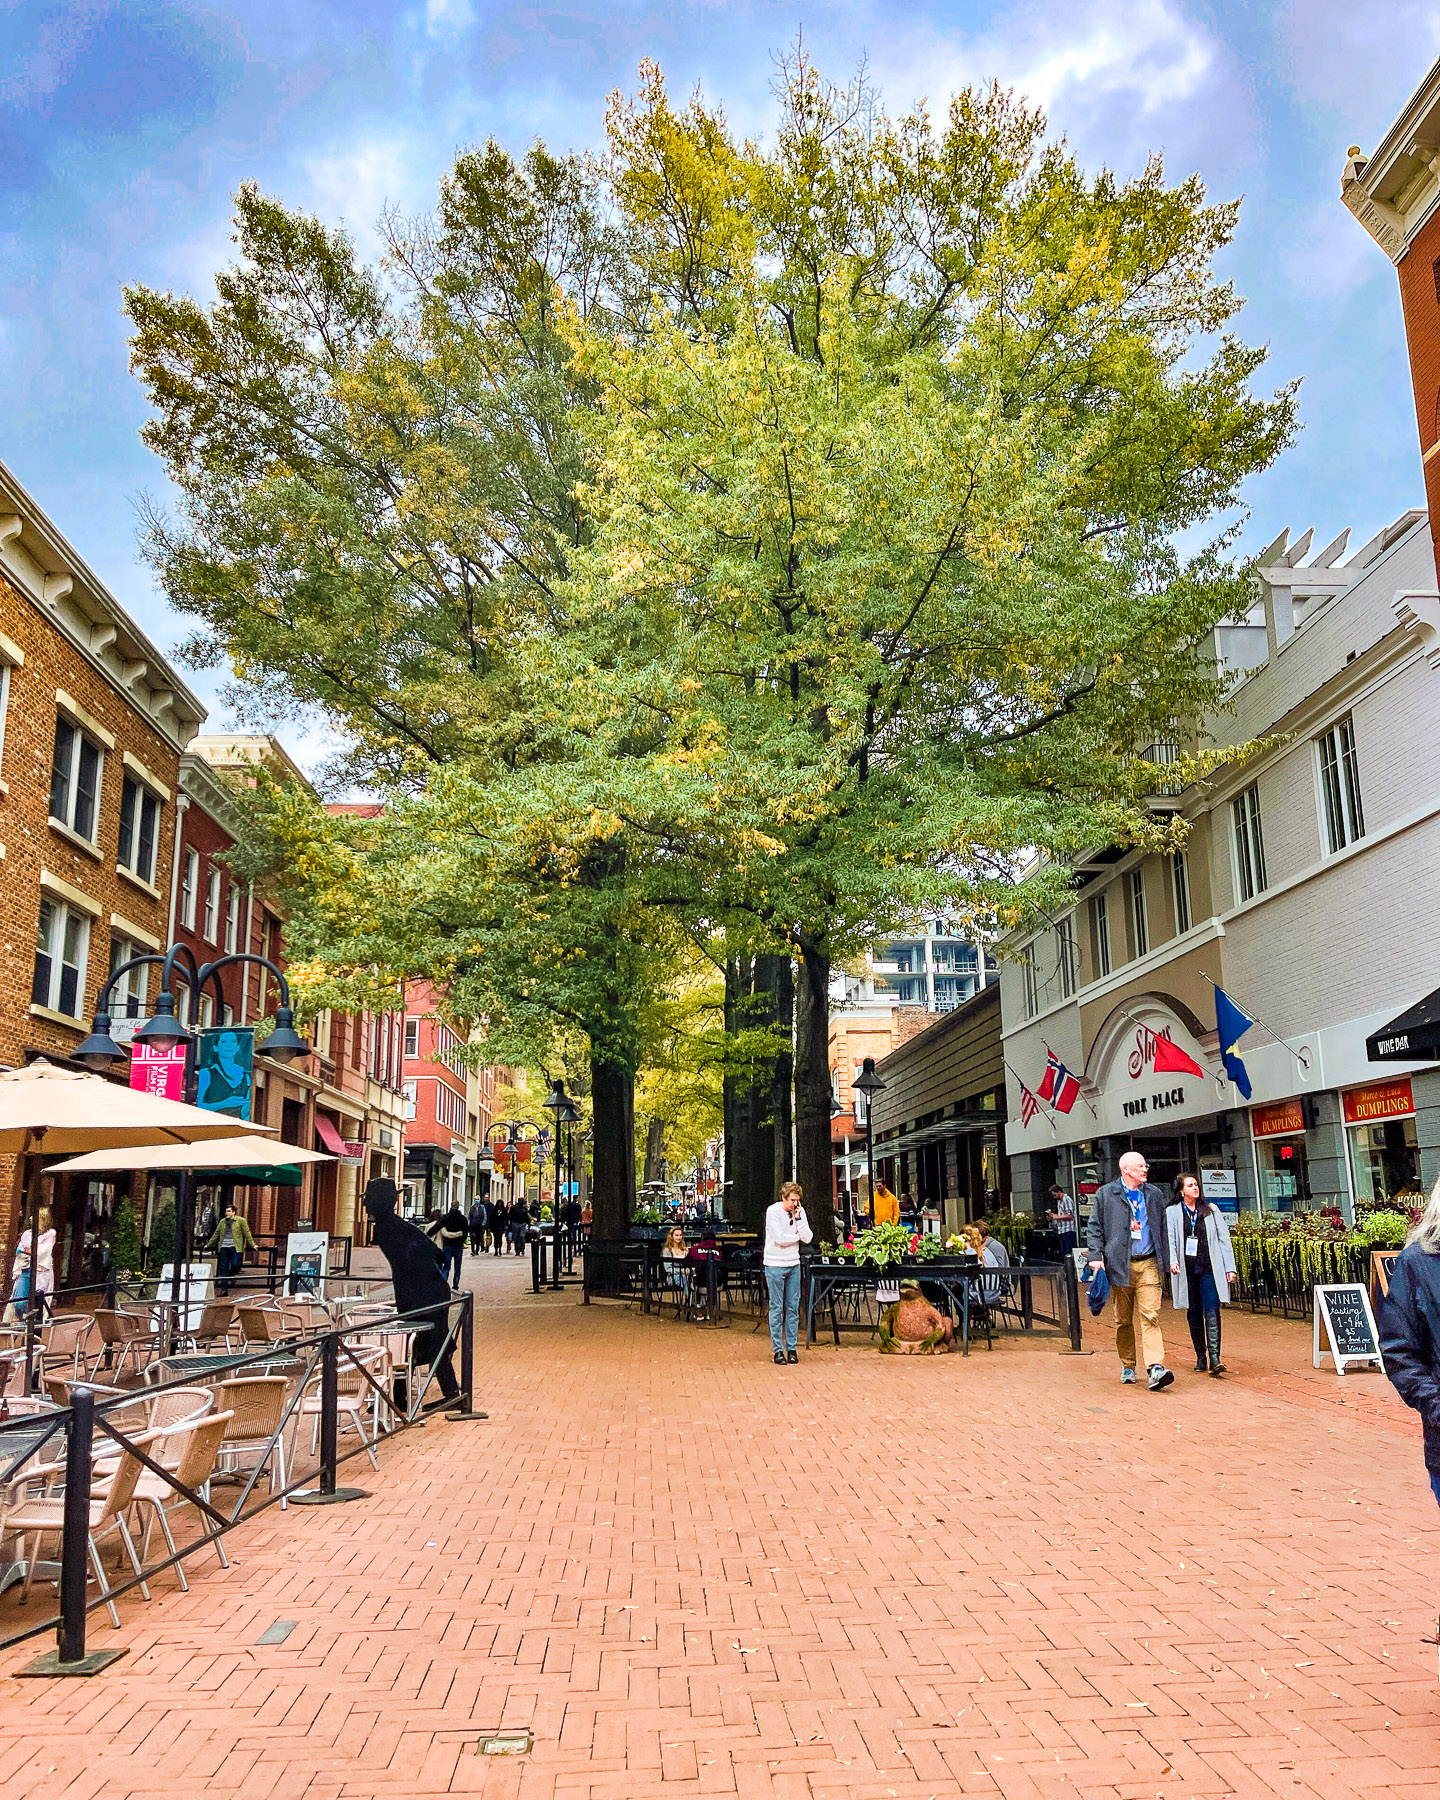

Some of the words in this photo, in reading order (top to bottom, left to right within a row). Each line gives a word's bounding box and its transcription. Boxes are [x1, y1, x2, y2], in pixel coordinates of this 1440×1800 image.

[1377, 1039, 1395, 1054] WINE
[1395, 1035, 1410, 1051] BAR
[1122, 1097, 1148, 1117] YORK
[1151, 1087, 1185, 1110] PLACE
[1356, 1096, 1409, 1118] DUMPLINGS
[1262, 1115, 1302, 1132] DUMPLINGS
[1281, 1146, 1293, 1160] OPEN
[1325, 1293, 1359, 1305] WINE
[1329, 1307, 1363, 1321] tasting
